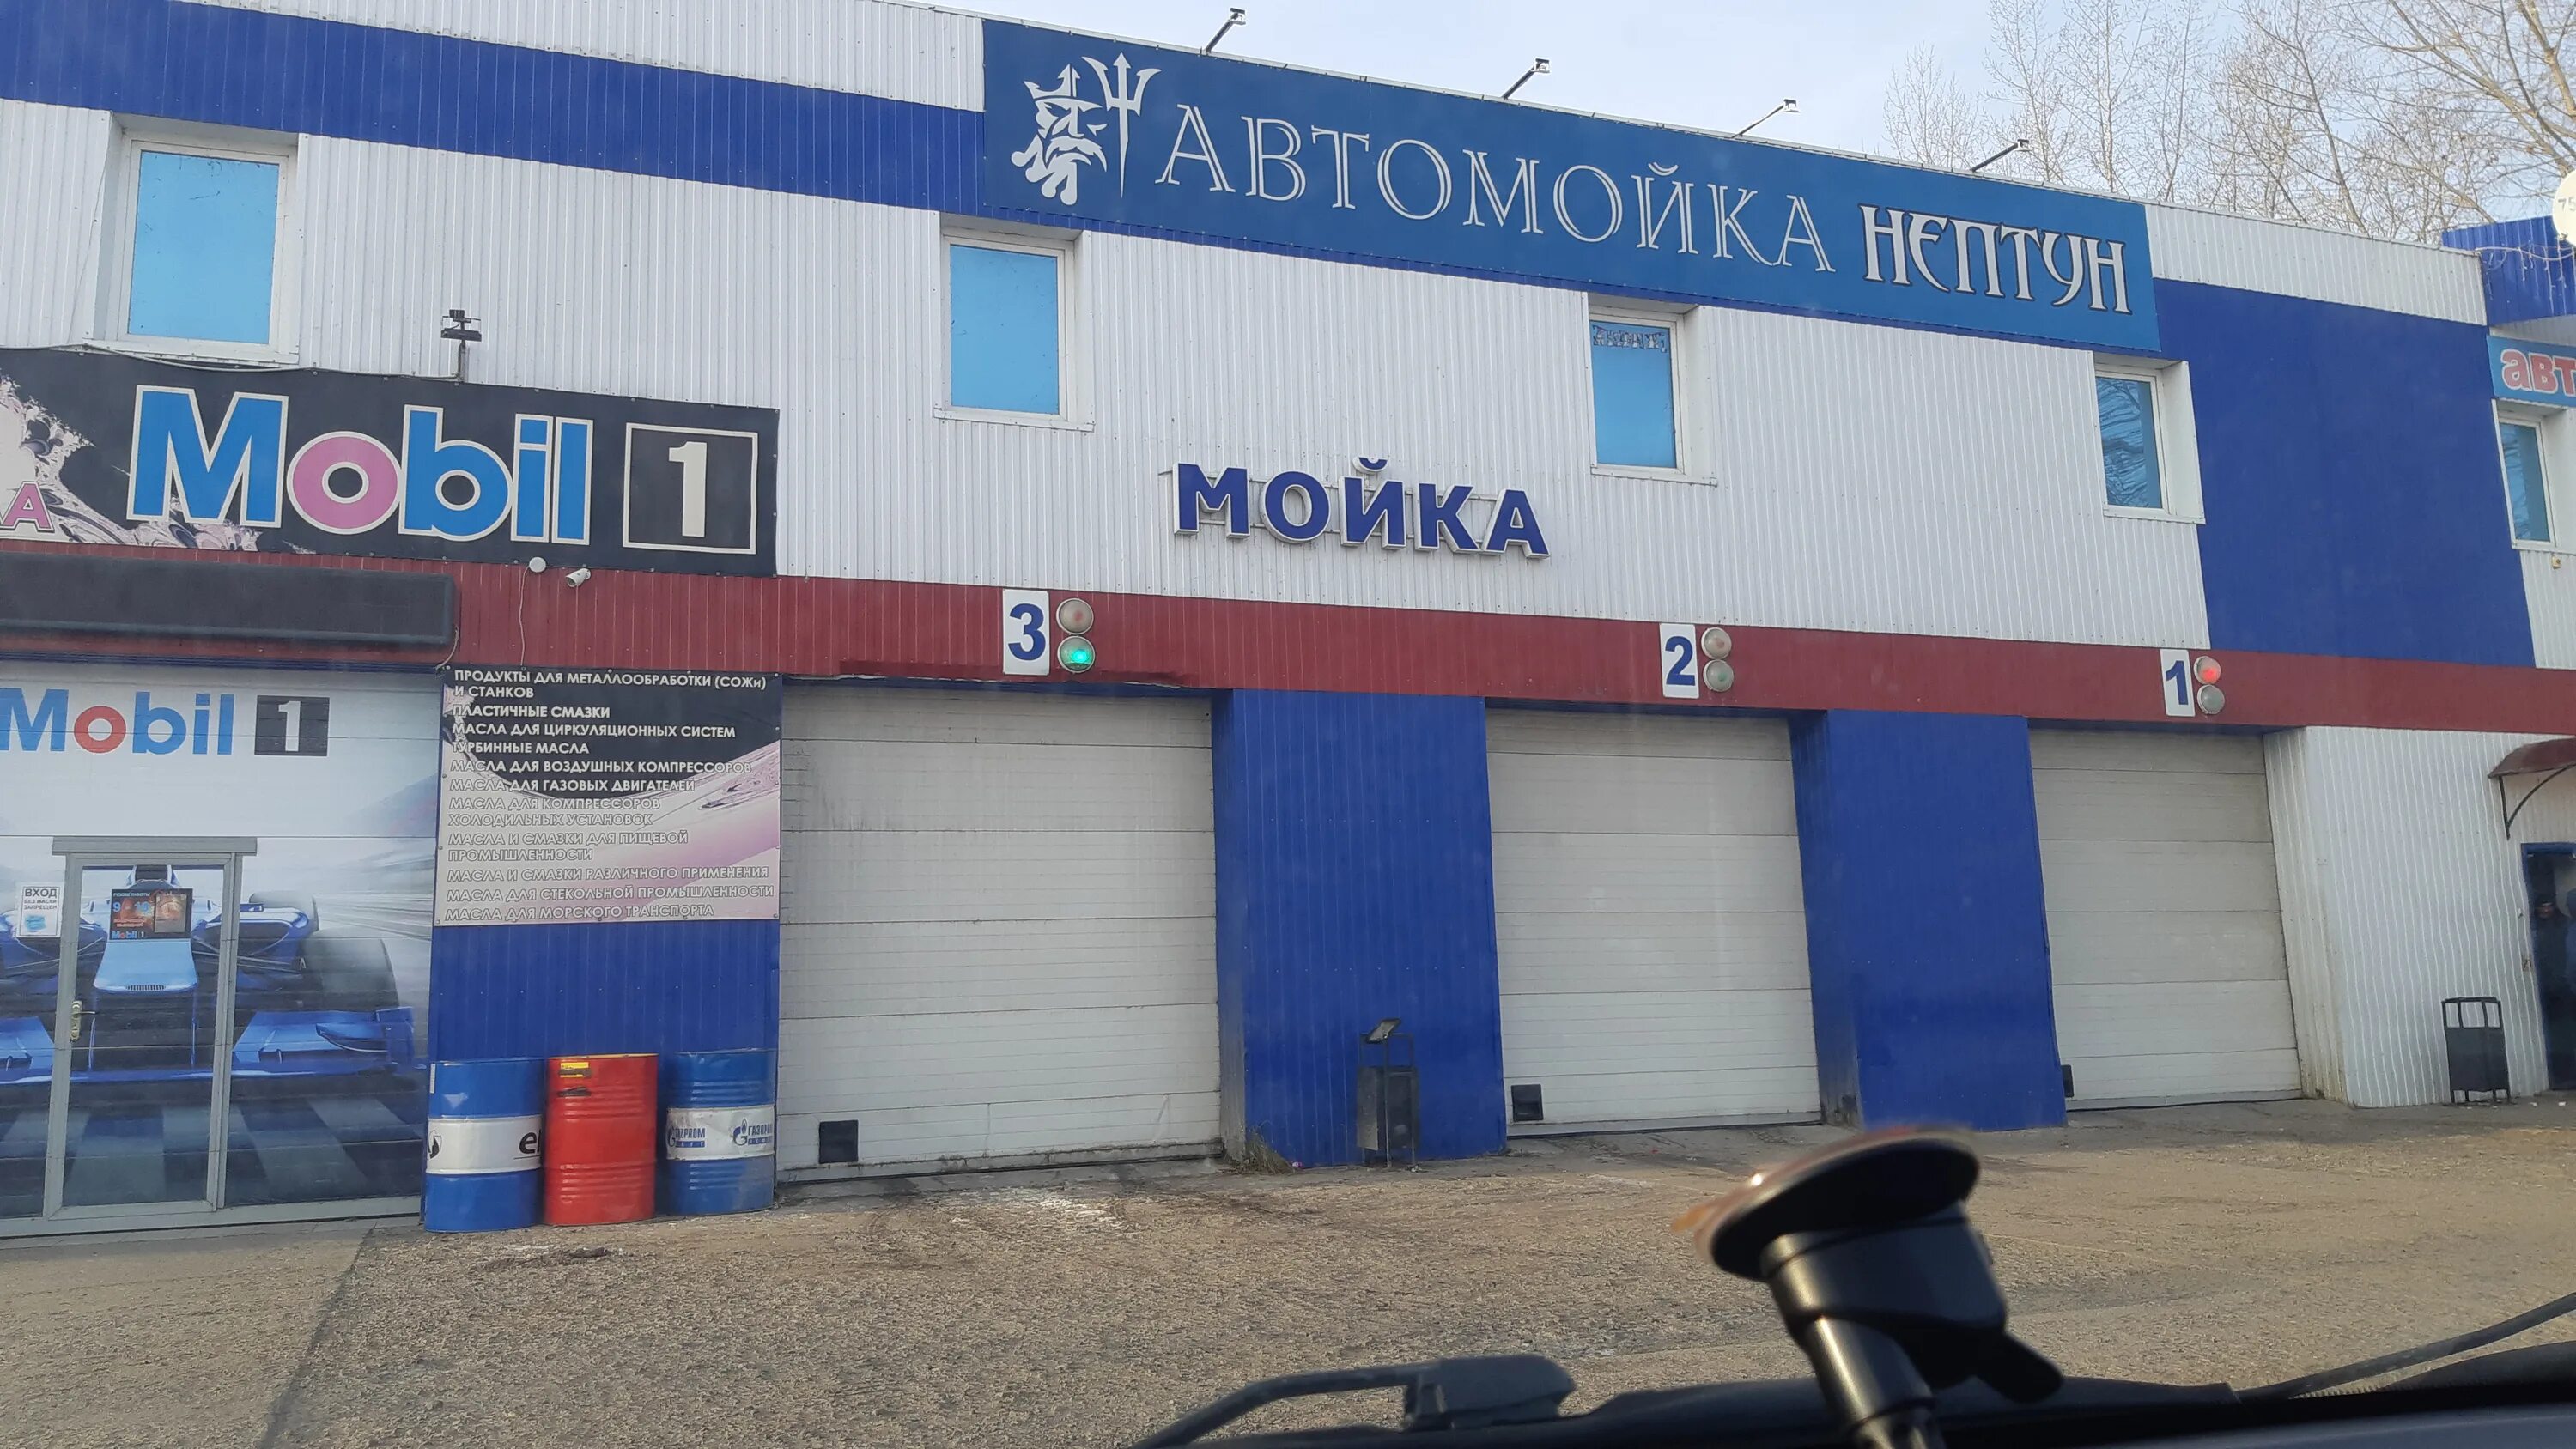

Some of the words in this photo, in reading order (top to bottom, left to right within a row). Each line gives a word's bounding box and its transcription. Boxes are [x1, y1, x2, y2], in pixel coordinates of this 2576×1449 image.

[1155, 104, 1837, 275] АВТОМОЙКА
[1858, 203, 2133, 315] НЕПТУН
[126, 385, 595, 546] Mobil
[668, 440, 708, 537] 1
[1171, 456, 1551, 560] МОЙКА
[1007, 603, 1047, 661] 3
[1664, 635, 1697, 686] 2
[454, 670, 531, 683] ПРОДУКТЫ
[534, 672, 563, 684] ДЛЯ
[567, 673, 712, 687] МЕТАЛЛООБРАБОТКИ
[2166, 659, 2190, 706] 1
[454, 686, 465, 697] И
[468, 686, 534, 698] СТАНКОВ
[453, 705, 548, 718] ПЛАСТИЧНЫЕ
[550, 706, 611, 718] СМАЗКИ
[0, 687, 235, 755] Mobil
[278, 700, 301, 752] 1
[452, 723, 507, 735] МАСЛА
[510, 724, 540, 737] ДЛЯ
[544, 724, 677, 738] ЦИРКУЛЯЦИОННЫХ
[681, 725, 736, 738] СИСТЕМ
[453, 741, 532, 754] ТУРБИННЫЕ
[535, 743, 590, 755] МАСЛА
[450, 760, 507, 772] МАСЛА
[509, 761, 539, 773] ДЛЯ
[543, 761, 635, 774] ВОЗДУШНЫХ
[638, 761, 752, 773] КОМПРЕССОРОВ
[449, 779, 506, 791] МАСЛА
[508, 779, 539, 792] ДЛЯ
[543, 779, 608, 791] ГАЗОВЫХ
[611, 778, 696, 792] ДВИГАТЕЛЕЙ
[448, 797, 506, 809] МАСЛА
[508, 797, 539, 811] ДЛЯ
[542, 797, 660, 810] КОМПРЕССОРОВ
[448, 814, 564, 827] ХОЛОДИЛЬНЫХ
[567, 814, 653, 826] УСТАНОВОК
[447, 833, 505, 846] МАСЛА
[508, 834, 519, 846] И
[522, 832, 584, 846] СМАЗКИ
[586, 832, 617, 846] ДЛЯ
[619, 829, 689, 845] ПИЩЕВОЙ
[447, 848, 593, 862] ПРОМЫШЛЕННОСТИ
[447, 870, 504, 882] МАСЛА
[507, 869, 518, 881] И
[520, 868, 582, 881] СМАЗКИ
[586, 867, 678, 880] РАЗЛИЧНОГО
[681, 866, 769, 880] ПРИМЕНЕНИЯ
[25, 888, 58, 899] ВХОД
[446, 889, 503, 902] МАСЛА
[506, 888, 537, 902] ДЛЯ
[539, 885, 634, 900] СТЕКОЛЬНОЙ
[637, 885, 774, 899] ПРОМЫШЛЕННОСТИ
[445, 908, 502, 921] МАСЛА
[505, 907, 536, 922] ДЛЯ
[538, 906, 623, 919] МОРСКОГО
[625, 905, 715, 918] ТРАНСПОРТА
[111, 931, 138, 939] Mobil
